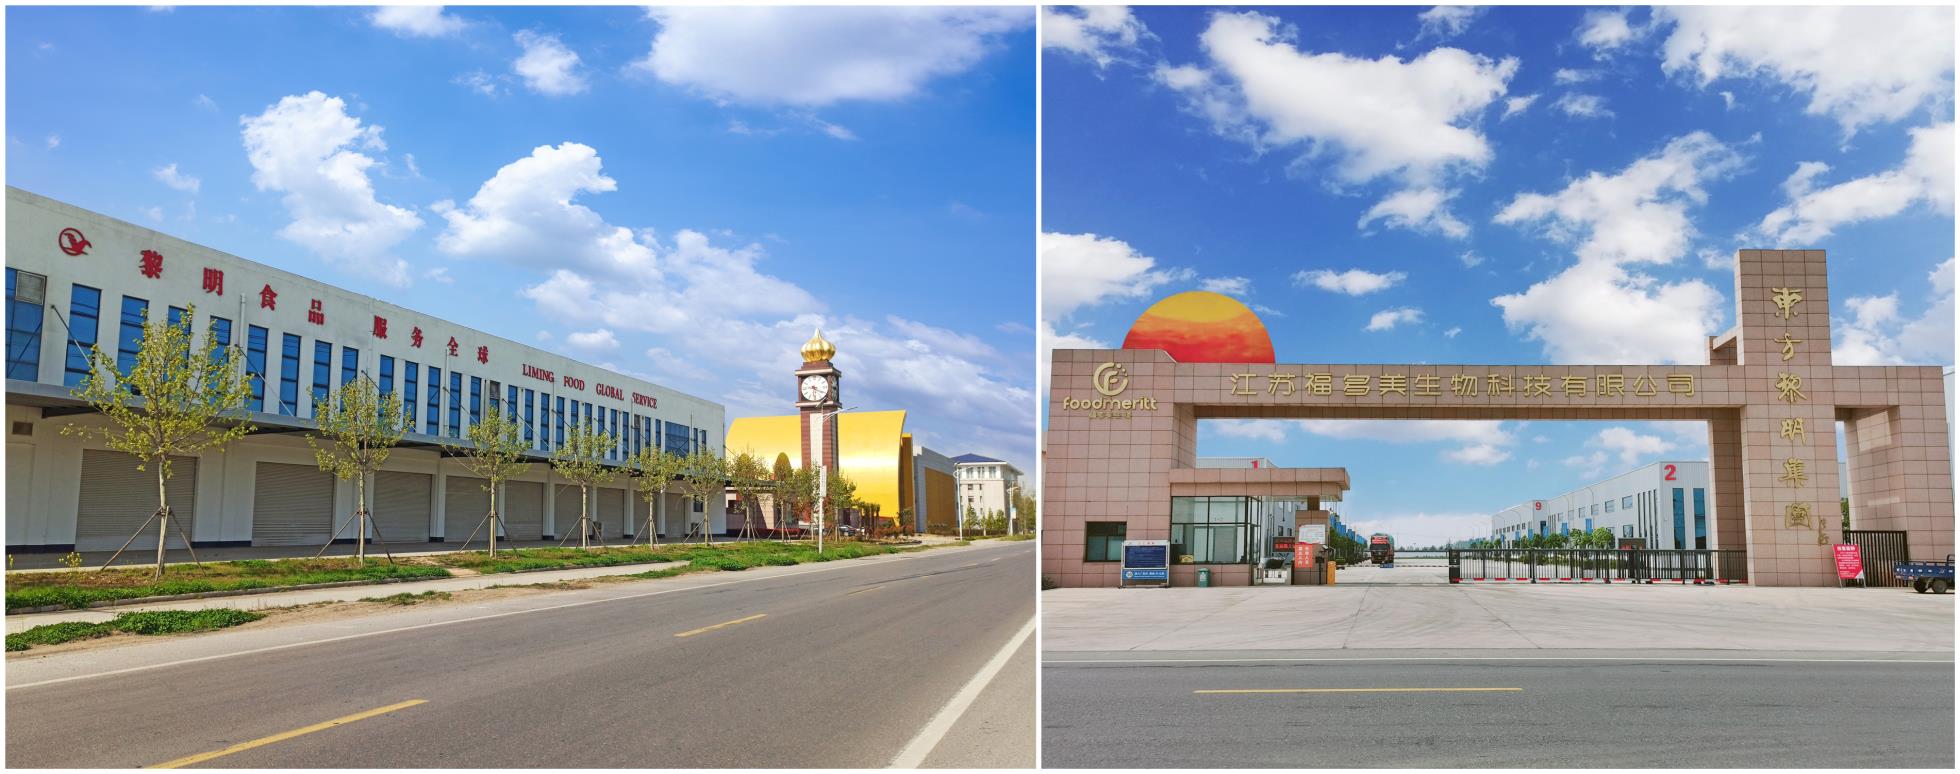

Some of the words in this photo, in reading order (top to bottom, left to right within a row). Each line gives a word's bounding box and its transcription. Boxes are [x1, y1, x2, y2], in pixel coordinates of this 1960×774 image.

[139, 250, 325, 326] 黎明食品
[373, 315, 489, 364] 服务全球
[522, 364, 555, 383] LIMING
[563, 376, 585, 391] FOOD
[596, 383, 624, 401] GLOBAL
[632, 392, 657, 409] SERVICE
[1230, 372, 1695, 397] 江苏福多美生物科技有限公司
[1063, 396, 1158, 410] foodmeritt
[1664, 464, 1676, 481] 2
[1535, 502, 1542, 511] 9
